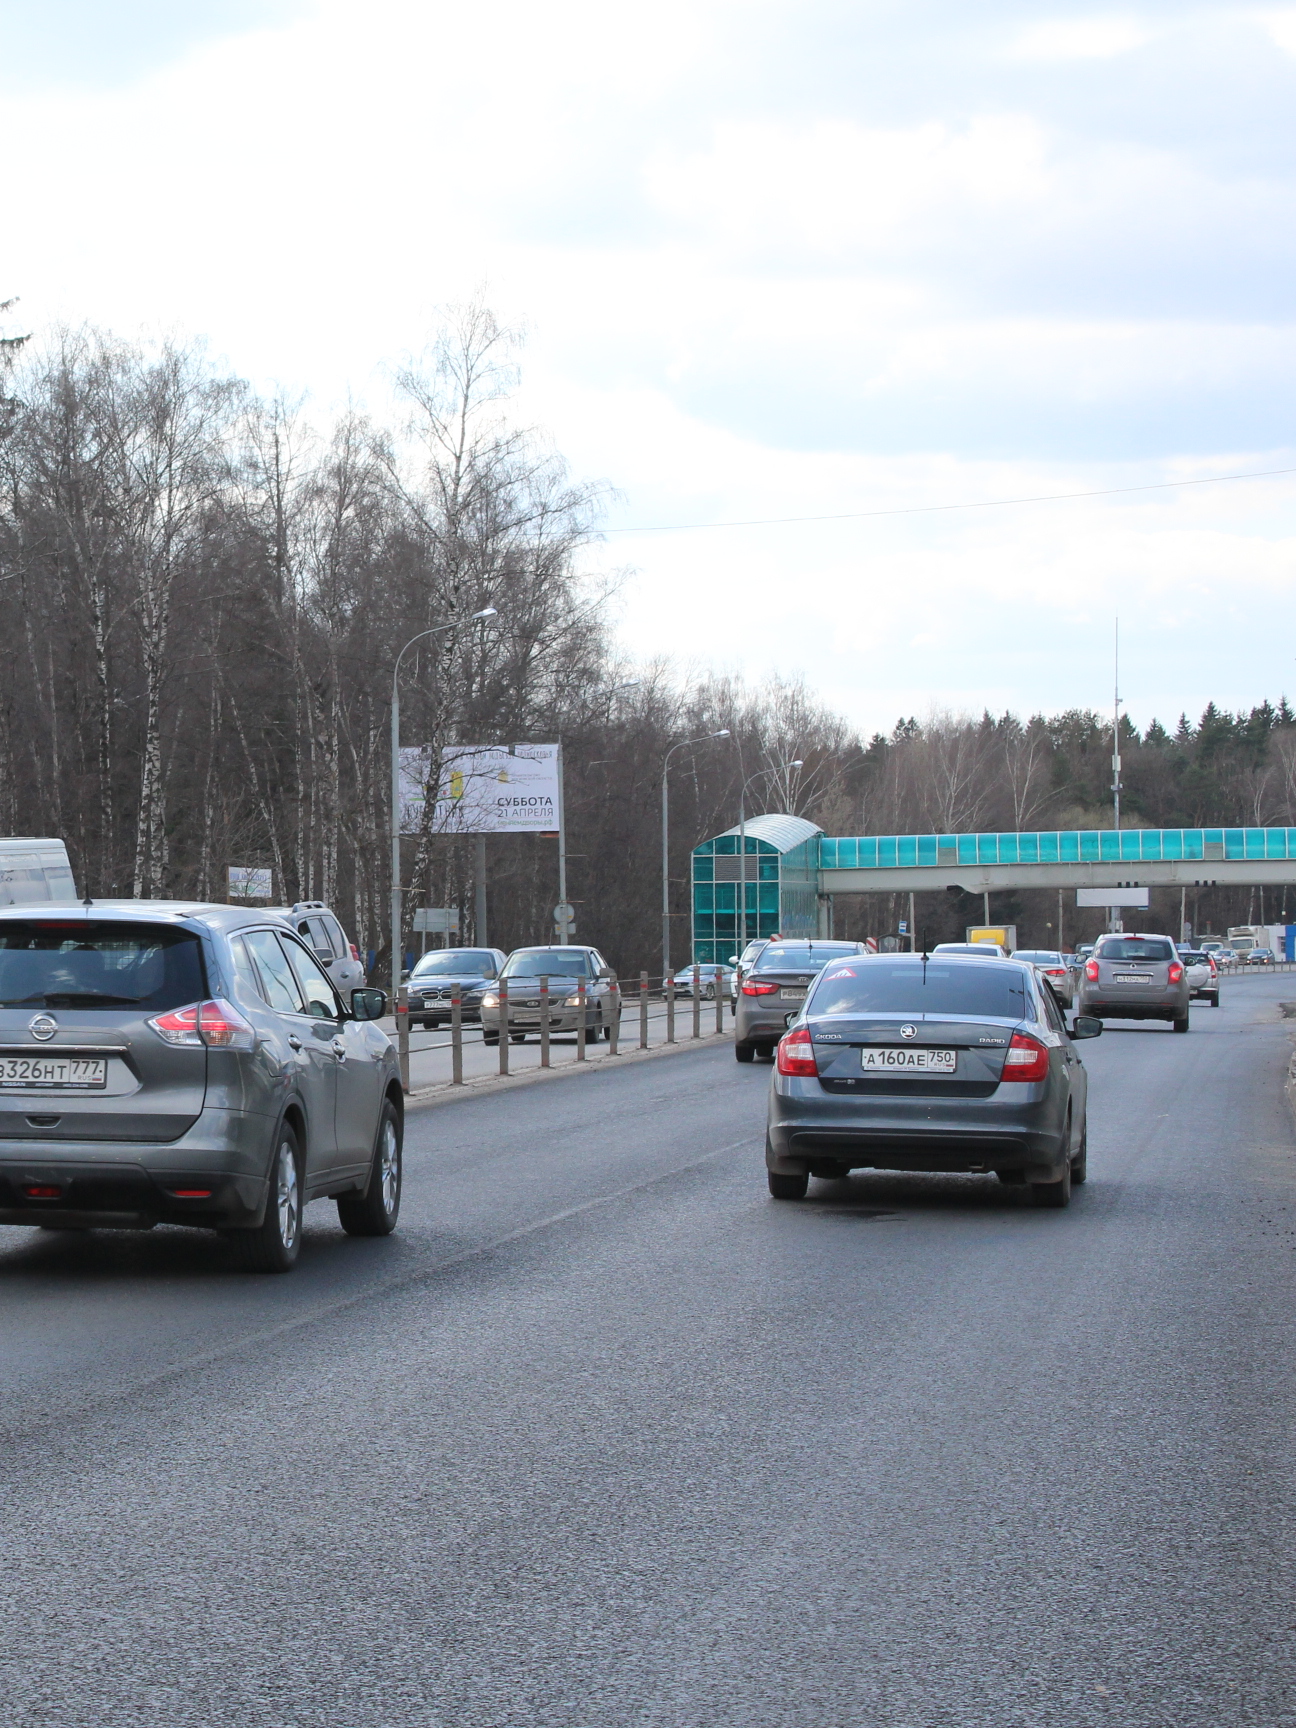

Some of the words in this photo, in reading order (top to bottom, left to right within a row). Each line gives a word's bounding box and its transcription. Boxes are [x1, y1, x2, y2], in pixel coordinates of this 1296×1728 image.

[497, 797, 552, 807] СУББОТА
[497, 809, 508, 817] 21
[512, 808, 554, 817] АПРЕЛЯ
[929, 1051, 951, 1062] 750
[72, 1060, 100, 1075] 777
